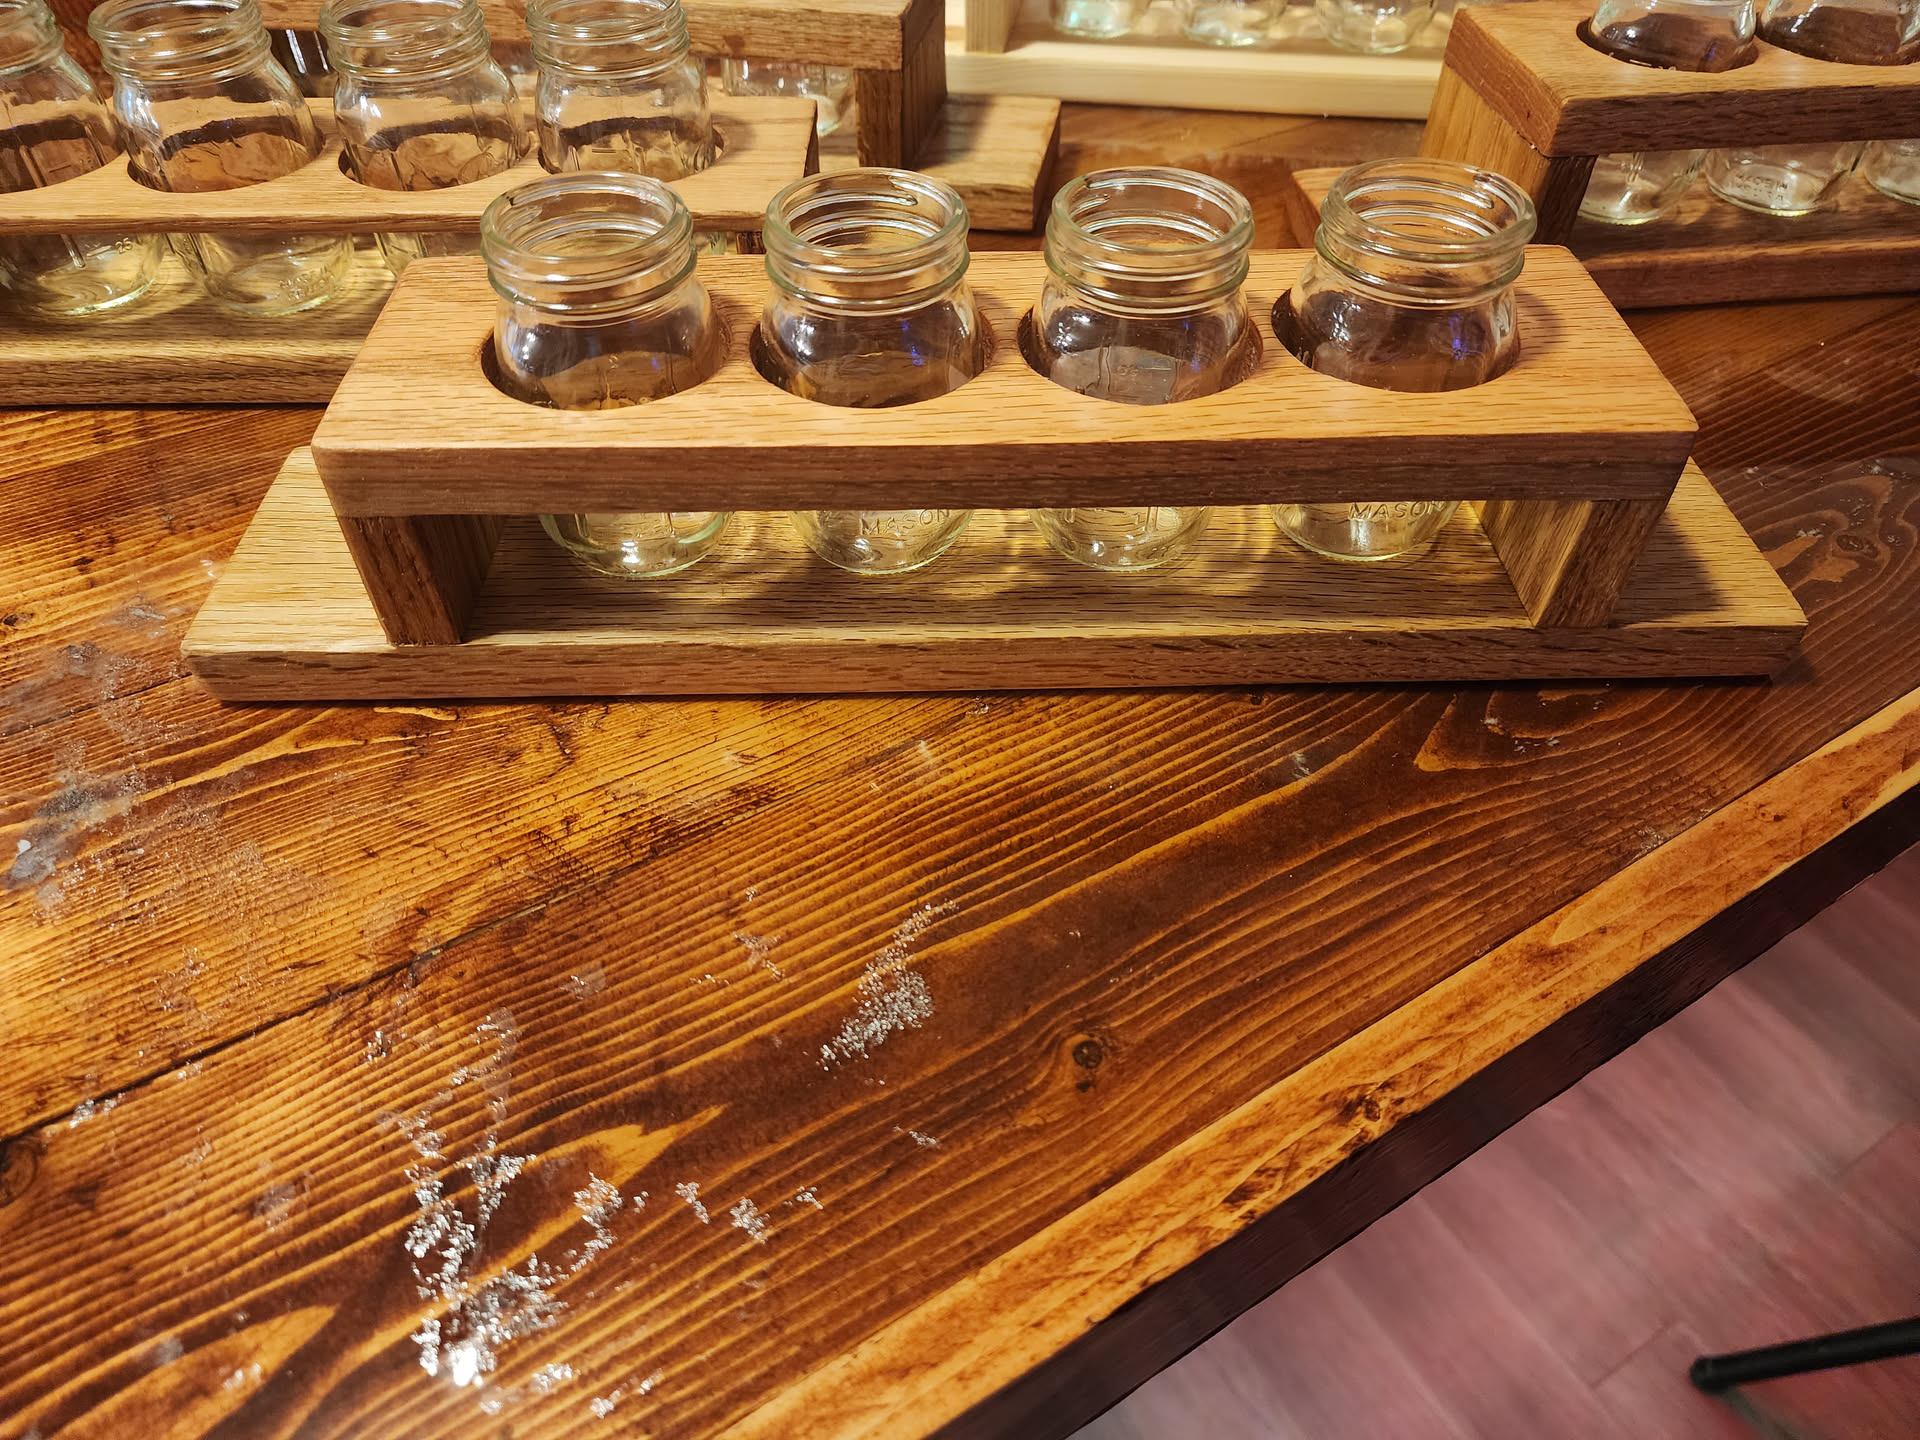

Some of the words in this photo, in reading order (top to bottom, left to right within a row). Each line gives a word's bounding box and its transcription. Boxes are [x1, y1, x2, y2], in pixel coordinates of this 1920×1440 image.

[115, 237, 133, 255] 25
[1350, 501, 1446, 520] MASON
[860, 510, 950, 535] MASON
